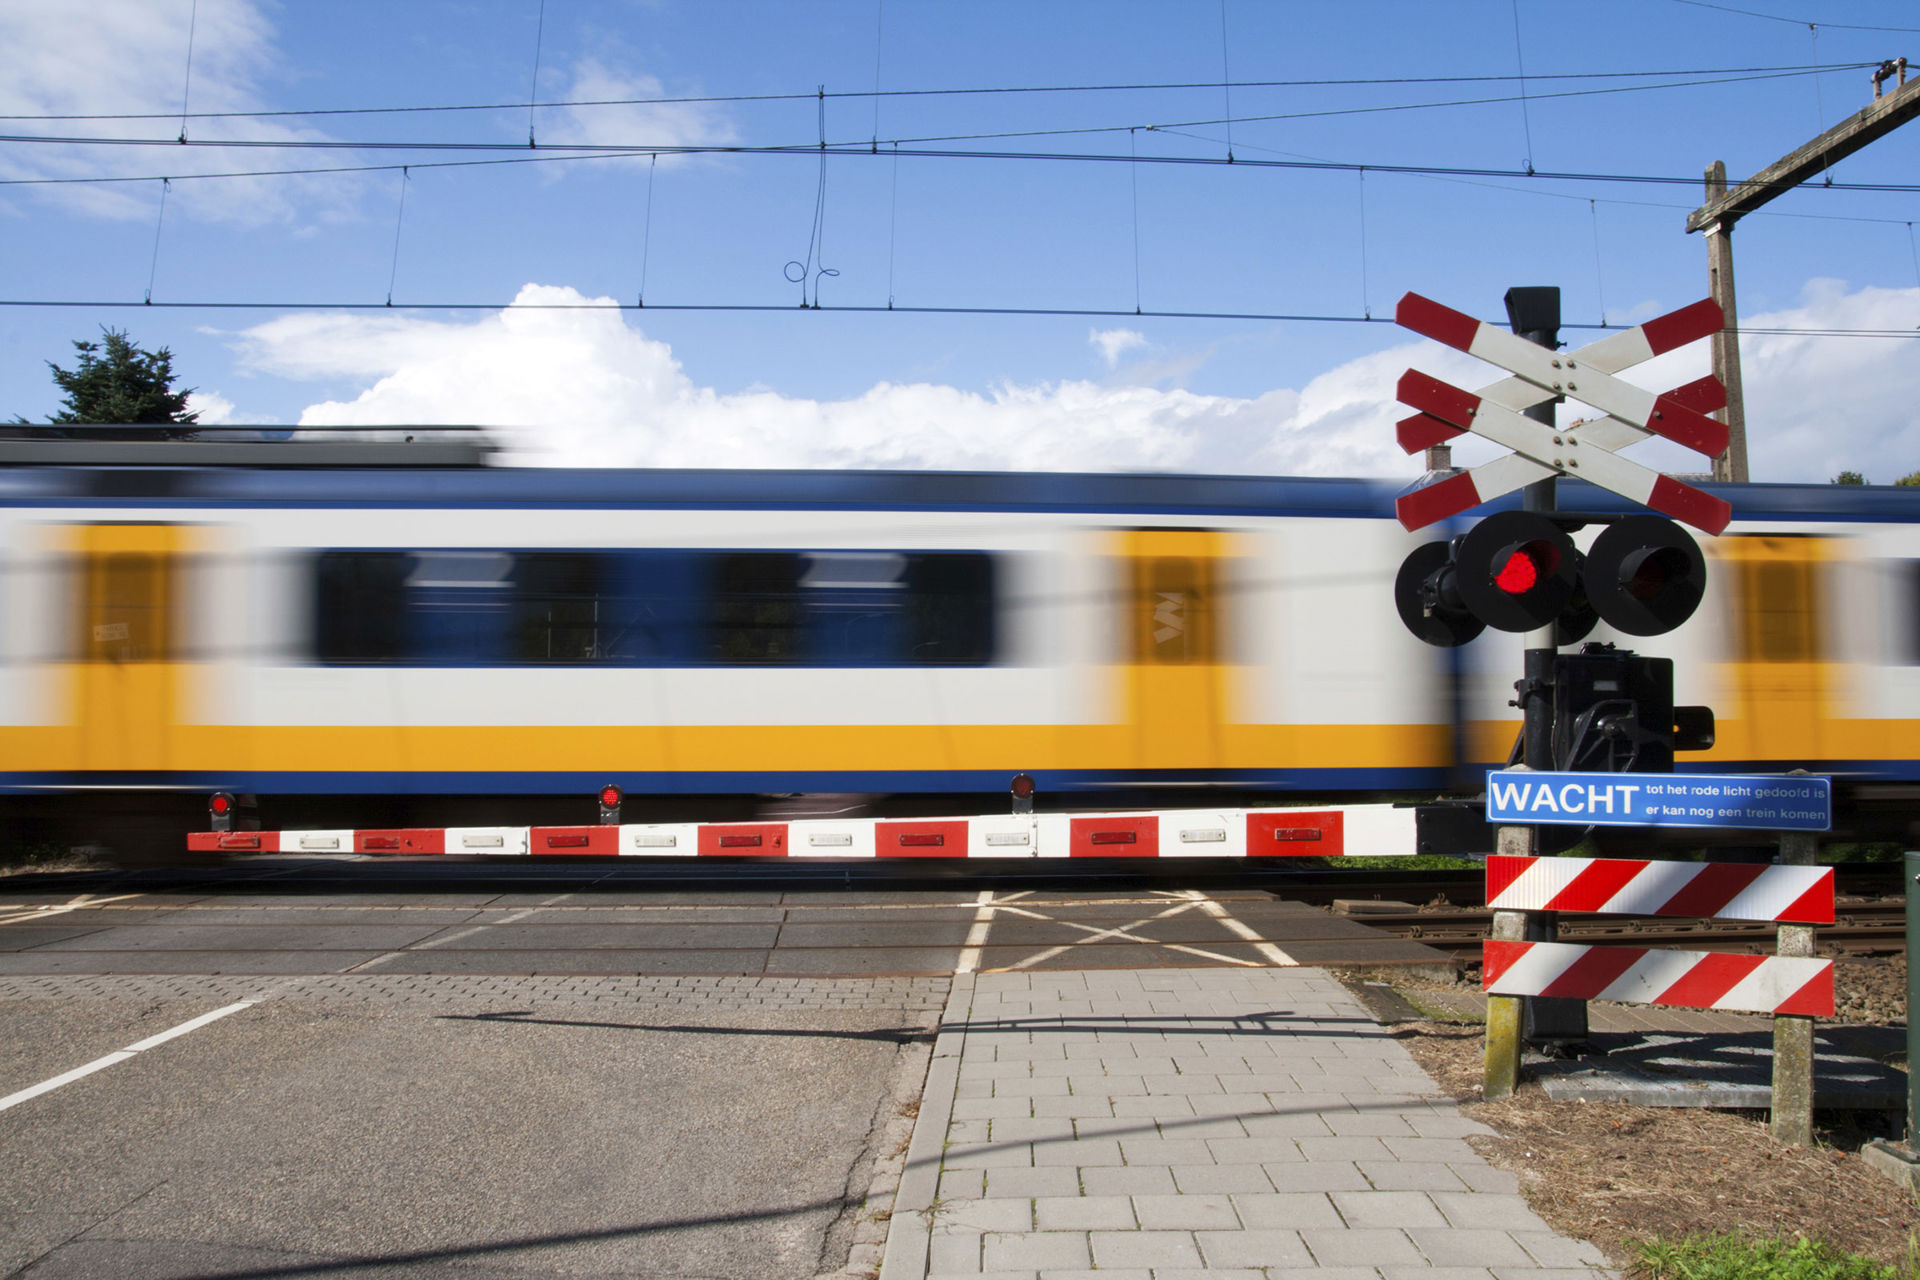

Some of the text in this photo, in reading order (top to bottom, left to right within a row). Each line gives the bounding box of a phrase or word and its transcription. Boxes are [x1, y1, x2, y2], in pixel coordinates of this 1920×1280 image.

[1491, 782, 1640, 814] WACHT
[1646, 785, 1826, 799] tot het rode licht gedoofd is
[1646, 805, 1826, 820] er kan nog een trein komen
